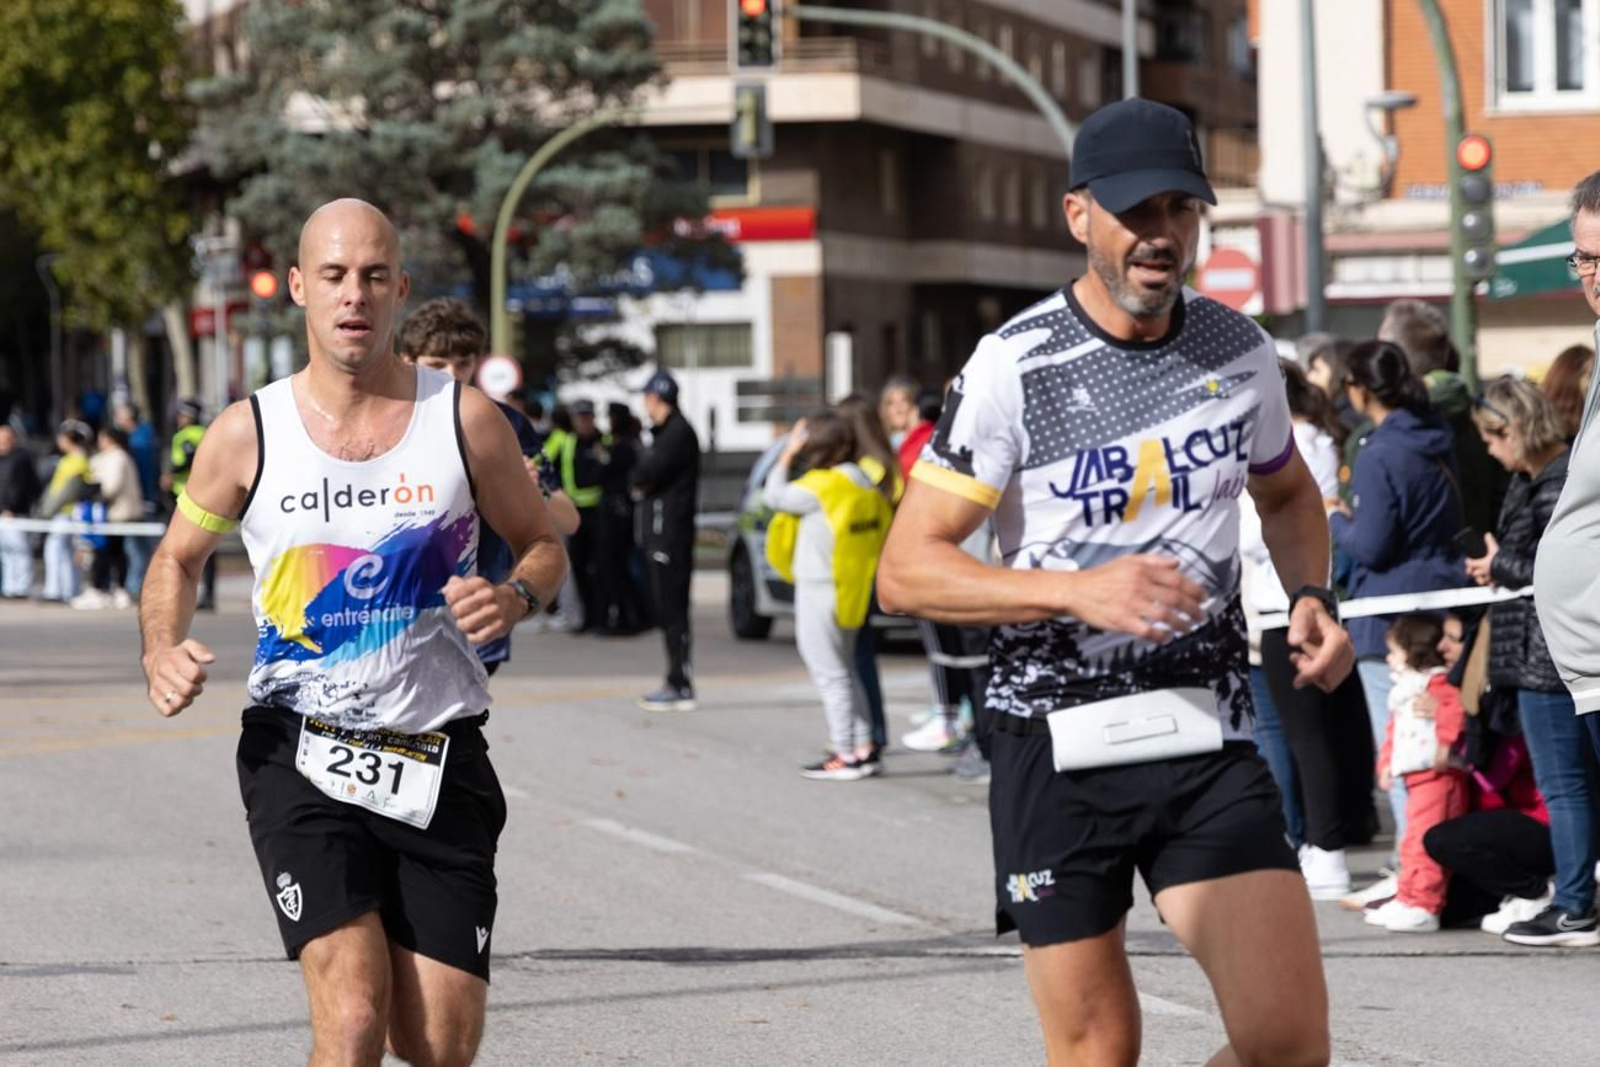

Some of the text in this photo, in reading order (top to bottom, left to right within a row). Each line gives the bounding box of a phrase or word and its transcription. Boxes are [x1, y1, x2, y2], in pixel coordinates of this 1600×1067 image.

[1049, 421, 1248, 499] JABALCUZ
[280, 472, 434, 523] calderón
[1072, 473, 1202, 527] TRAIL
[326, 745, 404, 795] 231
